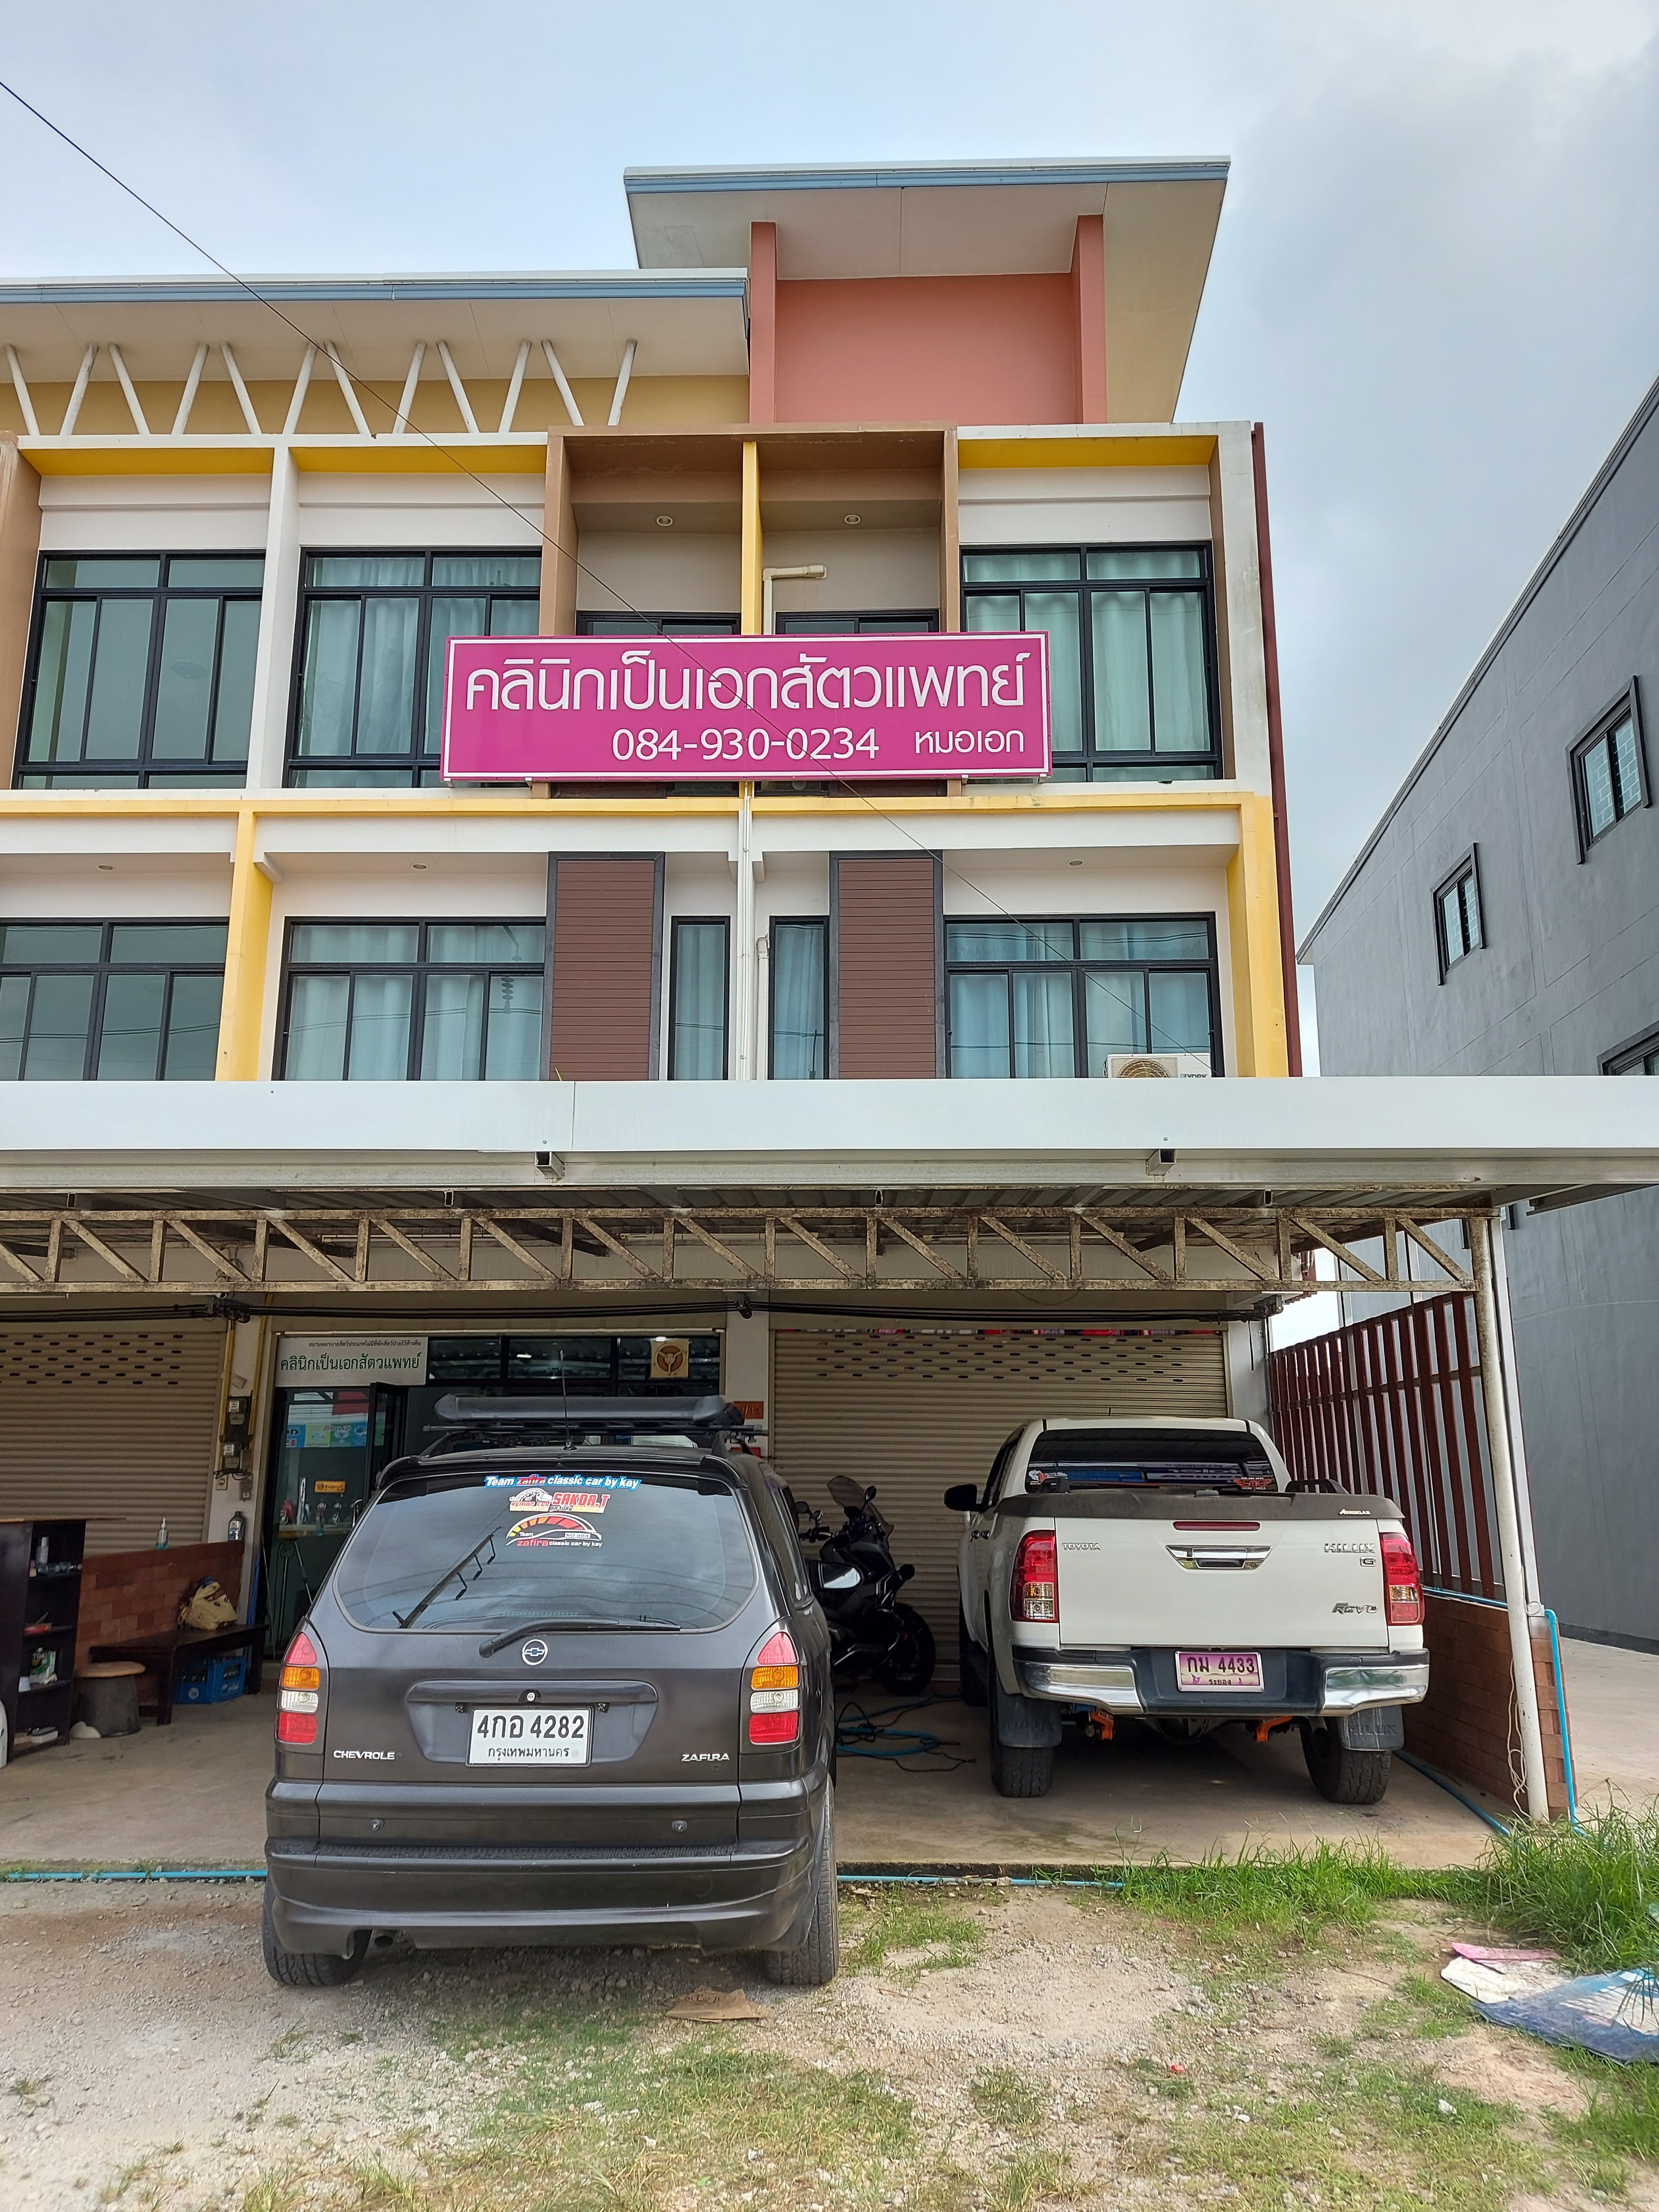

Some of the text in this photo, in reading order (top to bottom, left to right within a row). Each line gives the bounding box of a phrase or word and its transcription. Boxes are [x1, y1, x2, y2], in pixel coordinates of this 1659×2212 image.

[466, 650, 1031, 710] คลินิกเป็นเอกสัตวแพทย์
[612, 727, 1024, 761] 084-930-0234 หมอเอก
[281, 1352, 422, 1371] คลินิกเป็นเอกสัตวแพทย์
[486, 1476, 513, 1486] Team
[517, 1475, 546, 1485] zafira
[547, 1476, 585, 1485] classic
[603, 1477, 619, 1489] by
[619, 1477, 641, 1490] kay
[553, 1493, 610, 1506] SAKDA.T
[1062, 1542, 1101, 1550] TOYOTA
[1324, 1543, 1375, 1553] HILUX
[1187, 1657, 1255, 1673] กม 4433
[477, 1715, 584, 1738] 4กอ 4282
[488, 1747, 570, 1761] กรุงเทพมหานคร
[681, 1753, 730, 1761] ZAFIRA
